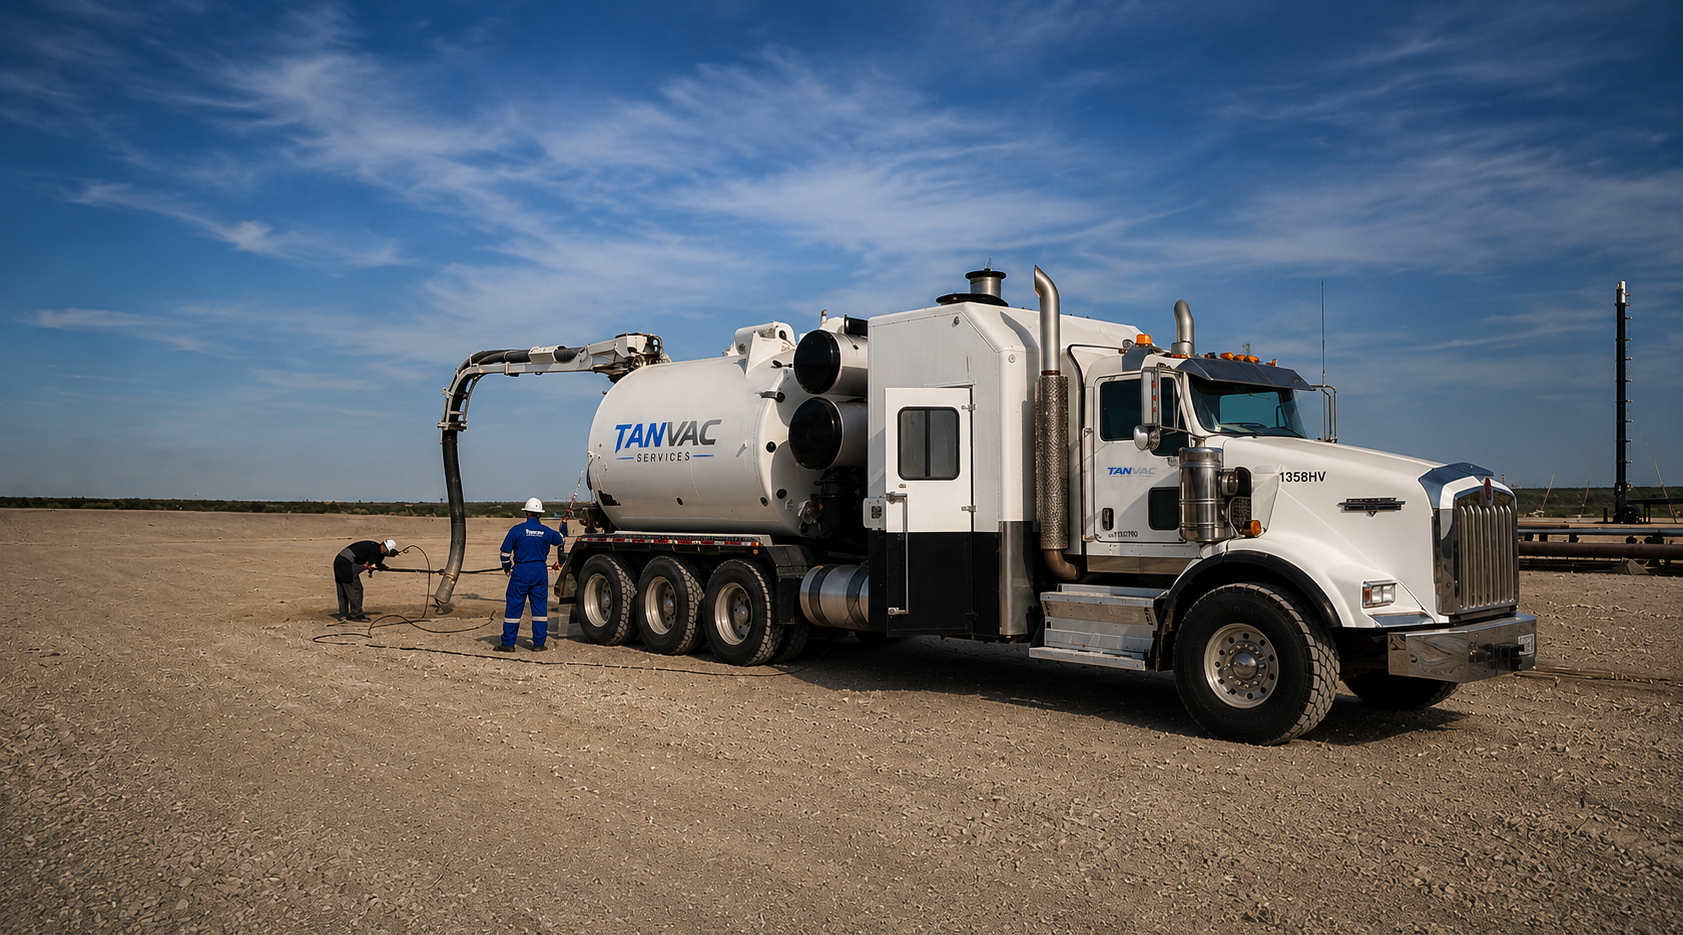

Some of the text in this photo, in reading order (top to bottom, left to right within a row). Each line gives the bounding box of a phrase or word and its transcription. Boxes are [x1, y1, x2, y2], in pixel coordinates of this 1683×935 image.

[615, 419, 722, 454] TANVAC
[636, 451, 690, 463] SERVICES
[1107, 467, 1157, 476] TANVAC
[1279, 471, 1326, 483] 1358HV
